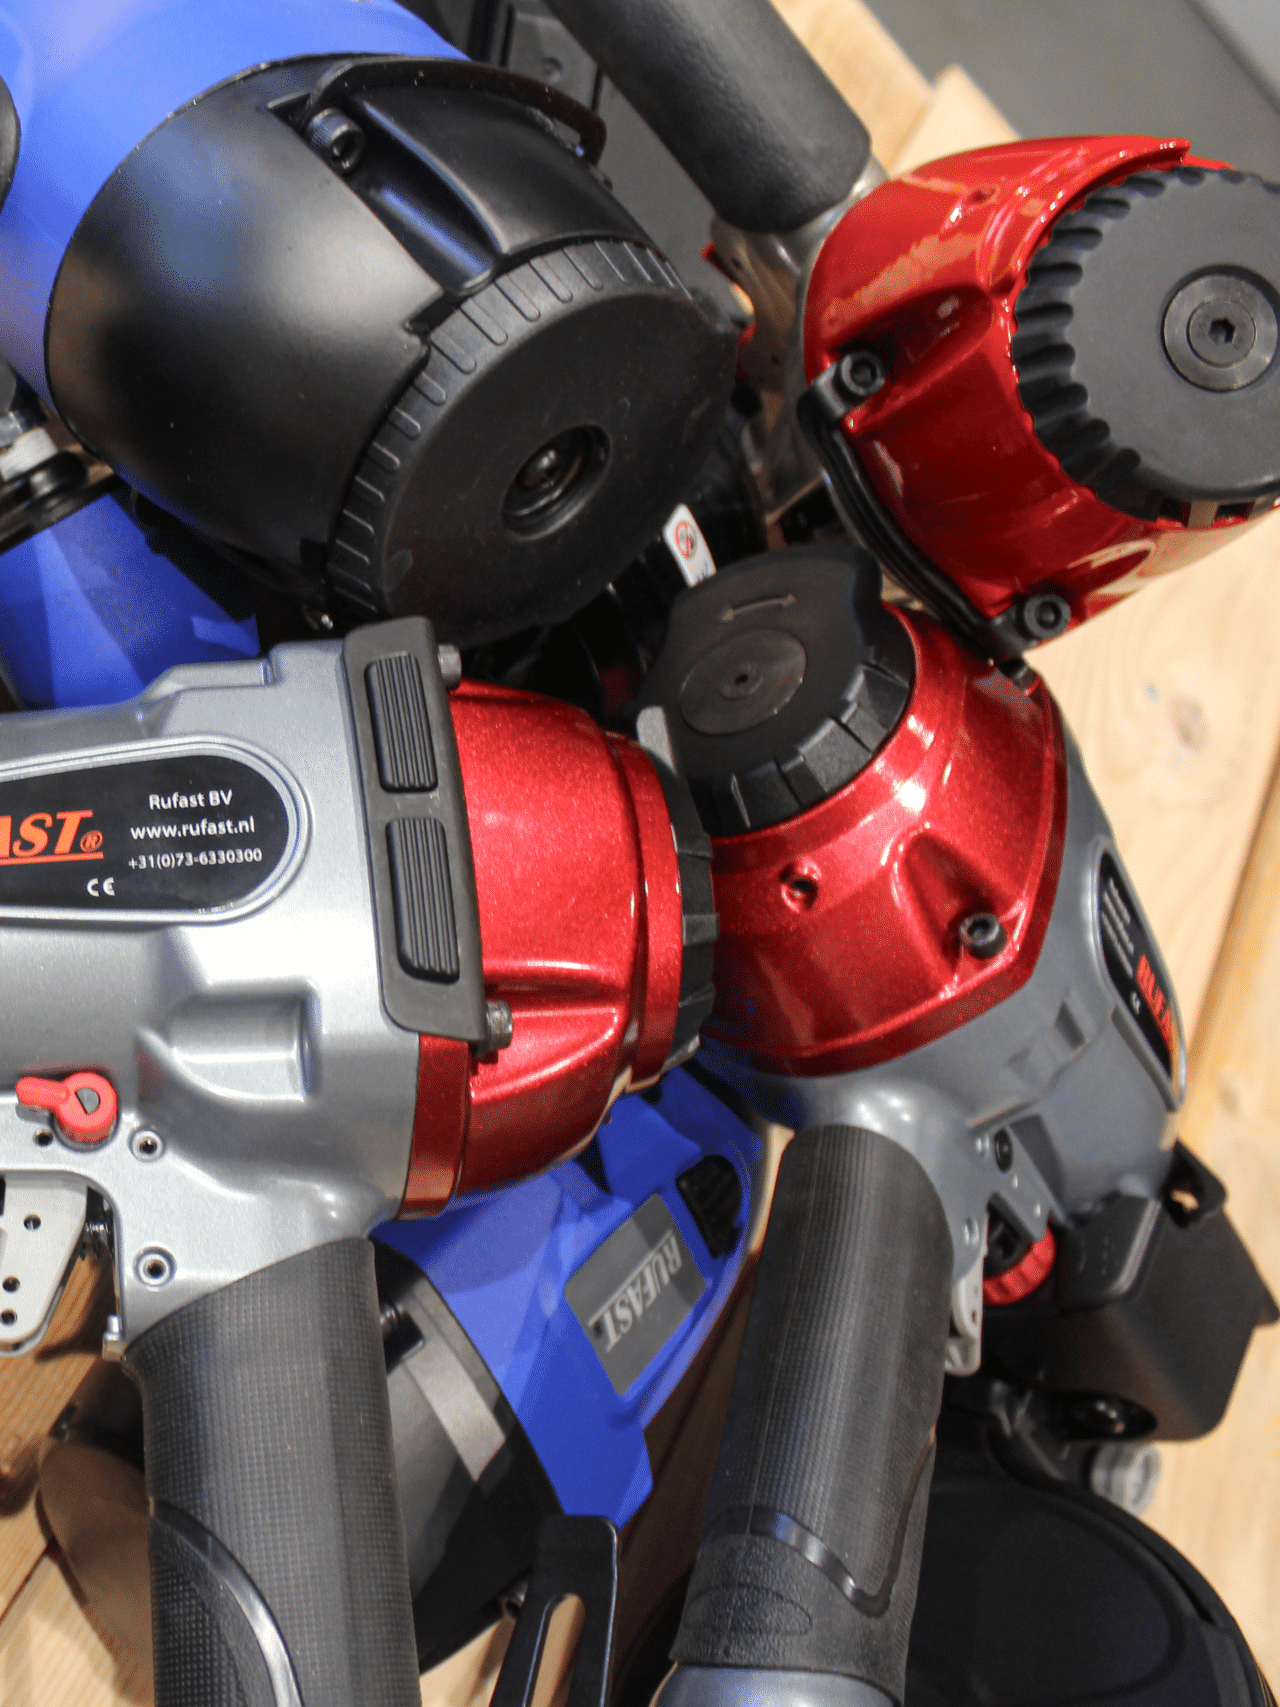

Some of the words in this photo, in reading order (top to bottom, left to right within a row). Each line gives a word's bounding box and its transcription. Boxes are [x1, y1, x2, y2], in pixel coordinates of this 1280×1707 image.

[148, 791, 205, 810] Rufast
[209, 789, 233, 806] BV
[130, 815, 255, 840] www.rufast.nl
[128, 848, 263, 870] +31(0)73-6330300
[86, 877, 116, 897] CE
